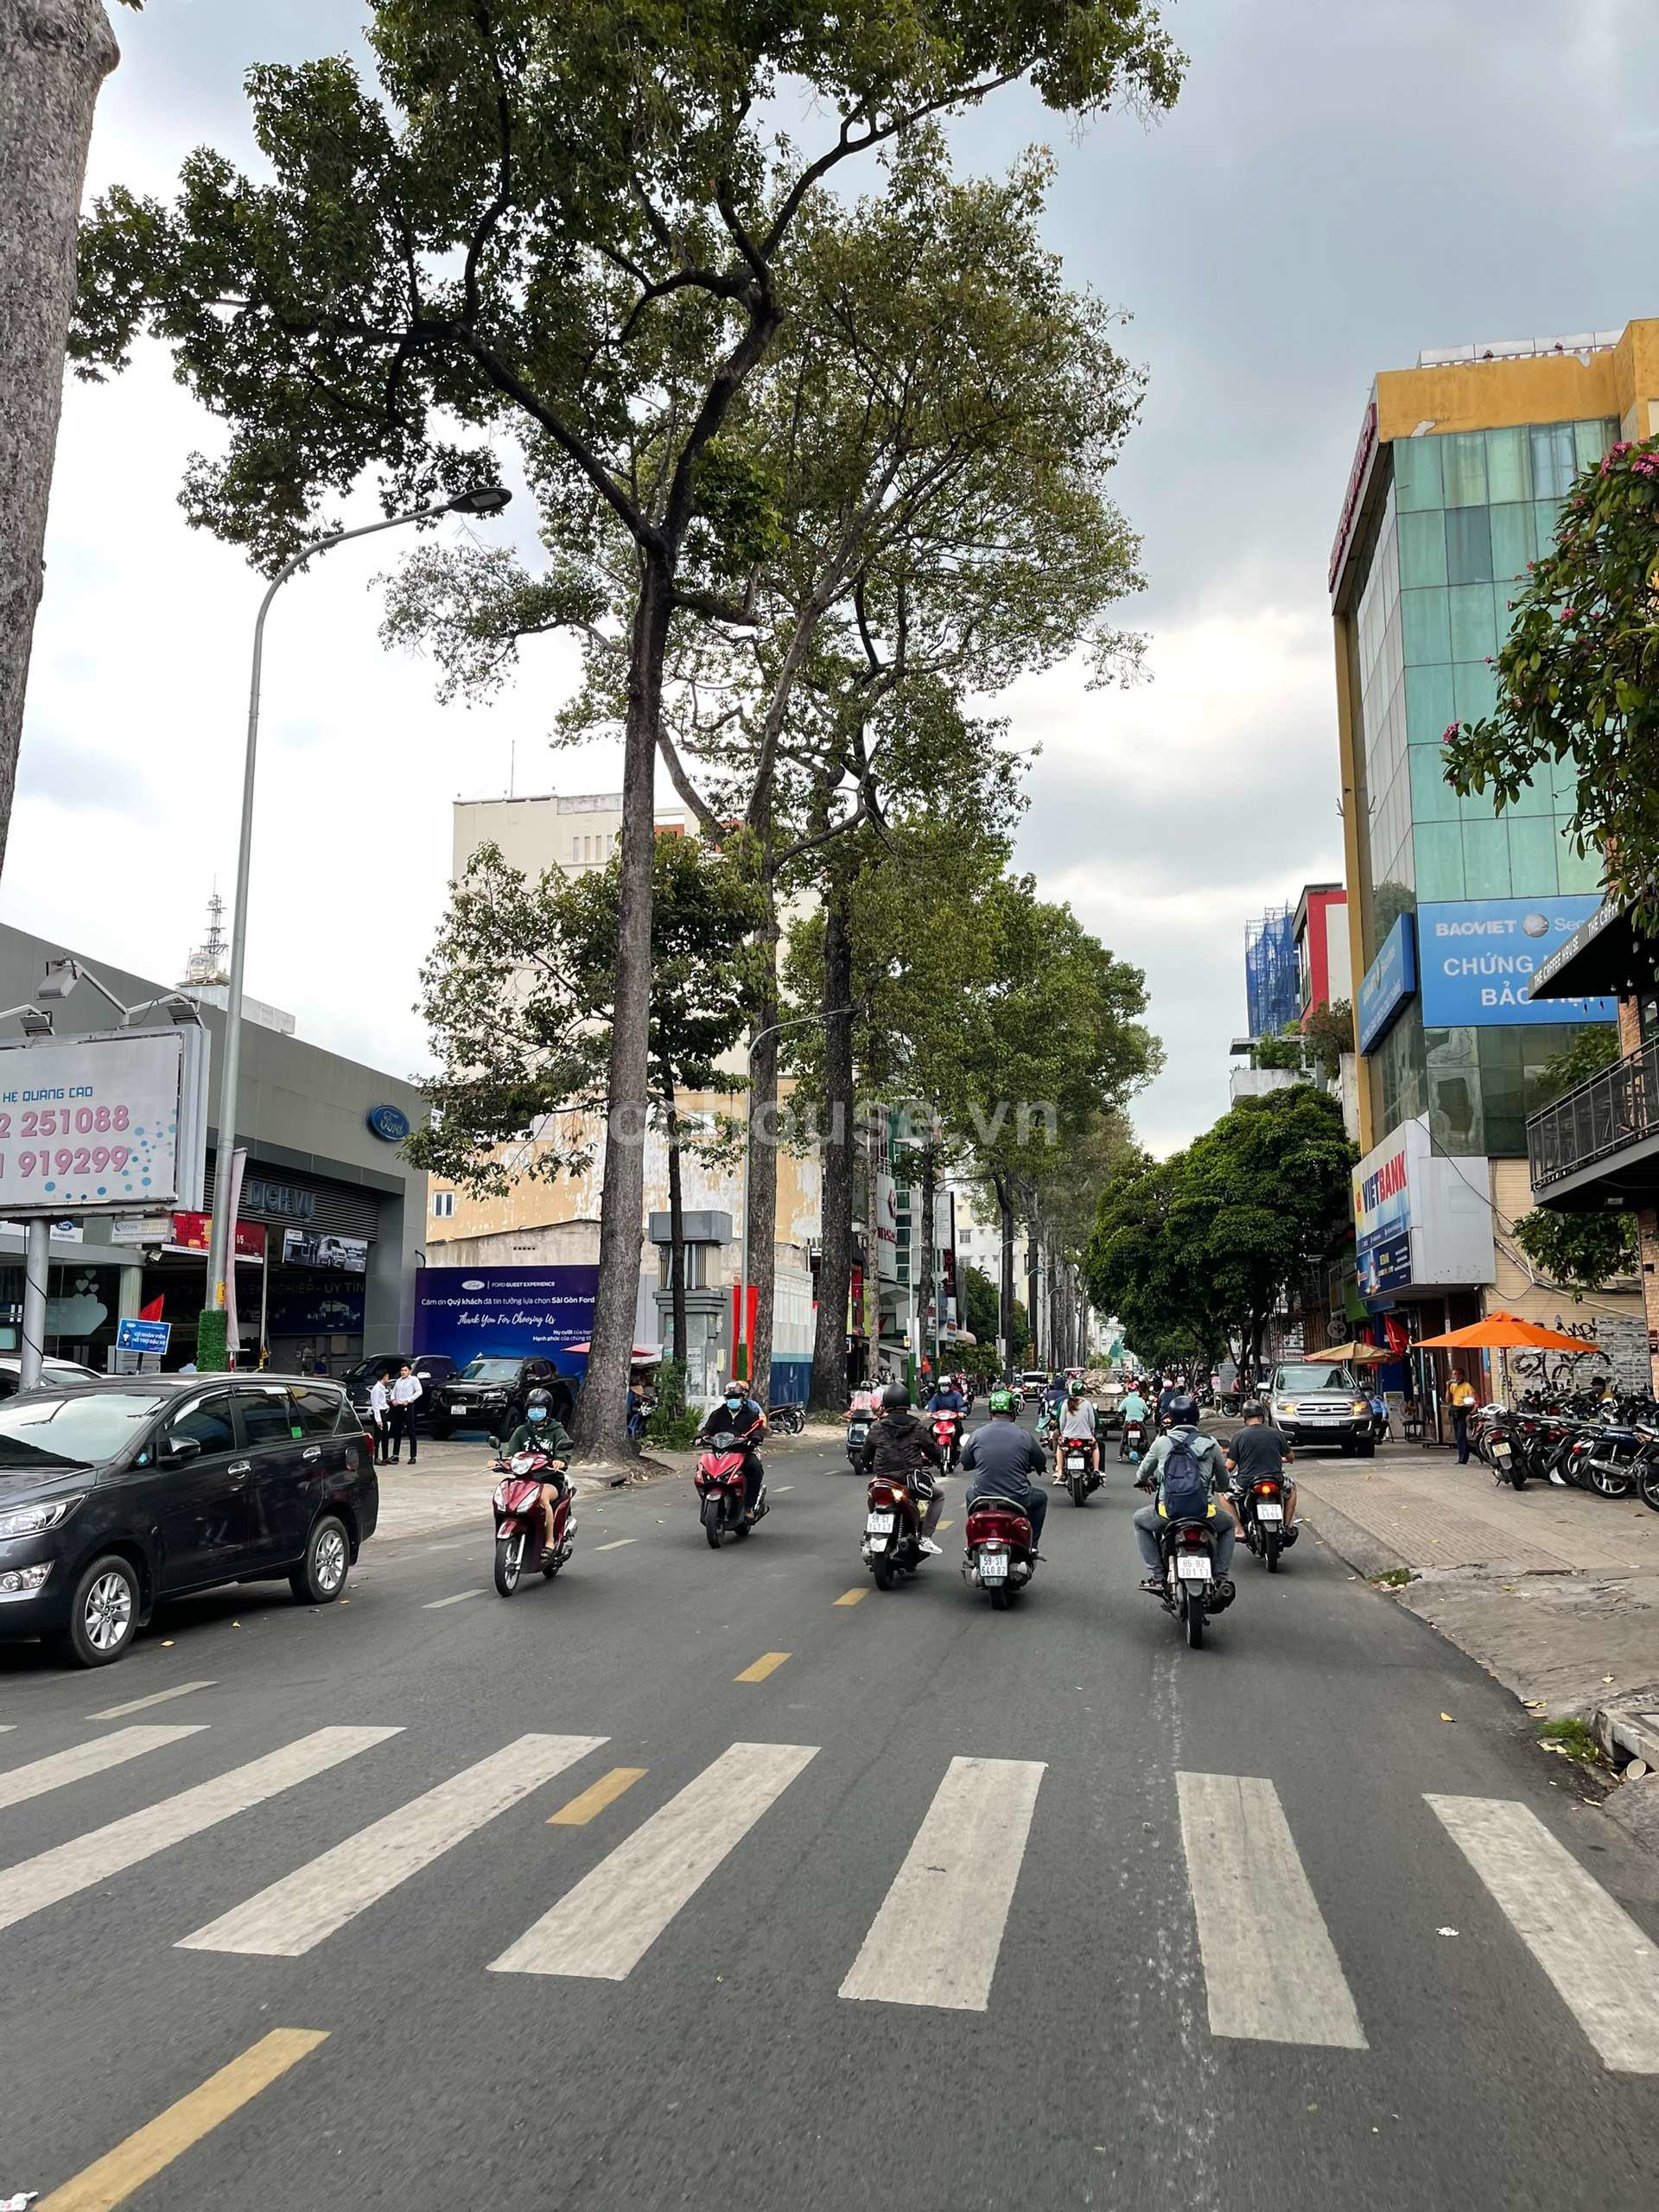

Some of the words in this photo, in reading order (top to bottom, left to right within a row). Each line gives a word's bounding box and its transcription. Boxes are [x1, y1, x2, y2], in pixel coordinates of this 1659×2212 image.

[1435, 920, 1517, 937] BAOVIET
[1588, 915, 1599, 938] THE
[1443, 952, 1534, 976] CHỨNG
[1534, 970, 1543, 988] THE
[1543, 952, 1561, 981] COFFEE
[1561, 935, 1580, 963] HOUSE
[22, 1086, 65, 1102] QUẢNG
[69, 1084, 93, 1098] CÁO
[21, 1104, 130, 1137] 251088
[380, 1110, 404, 1135] Ford
[18, 1146, 129, 1178] 919299
[1362, 1151, 1407, 1213] VIETBANK
[247, 1179, 291, 1213] DỊCH
[293, 1189, 316, 1223] VỤ
[447, 1298, 461, 1306] Quý
[534, 1297, 550, 1306] chọn
[456, 1312, 480, 1325] Thank
[480, 1314, 496, 1328] You
[497, 1314, 511, 1325] For
[512, 1311, 543, 1328] Choosing
[544, 1313, 556, 1325] Us
